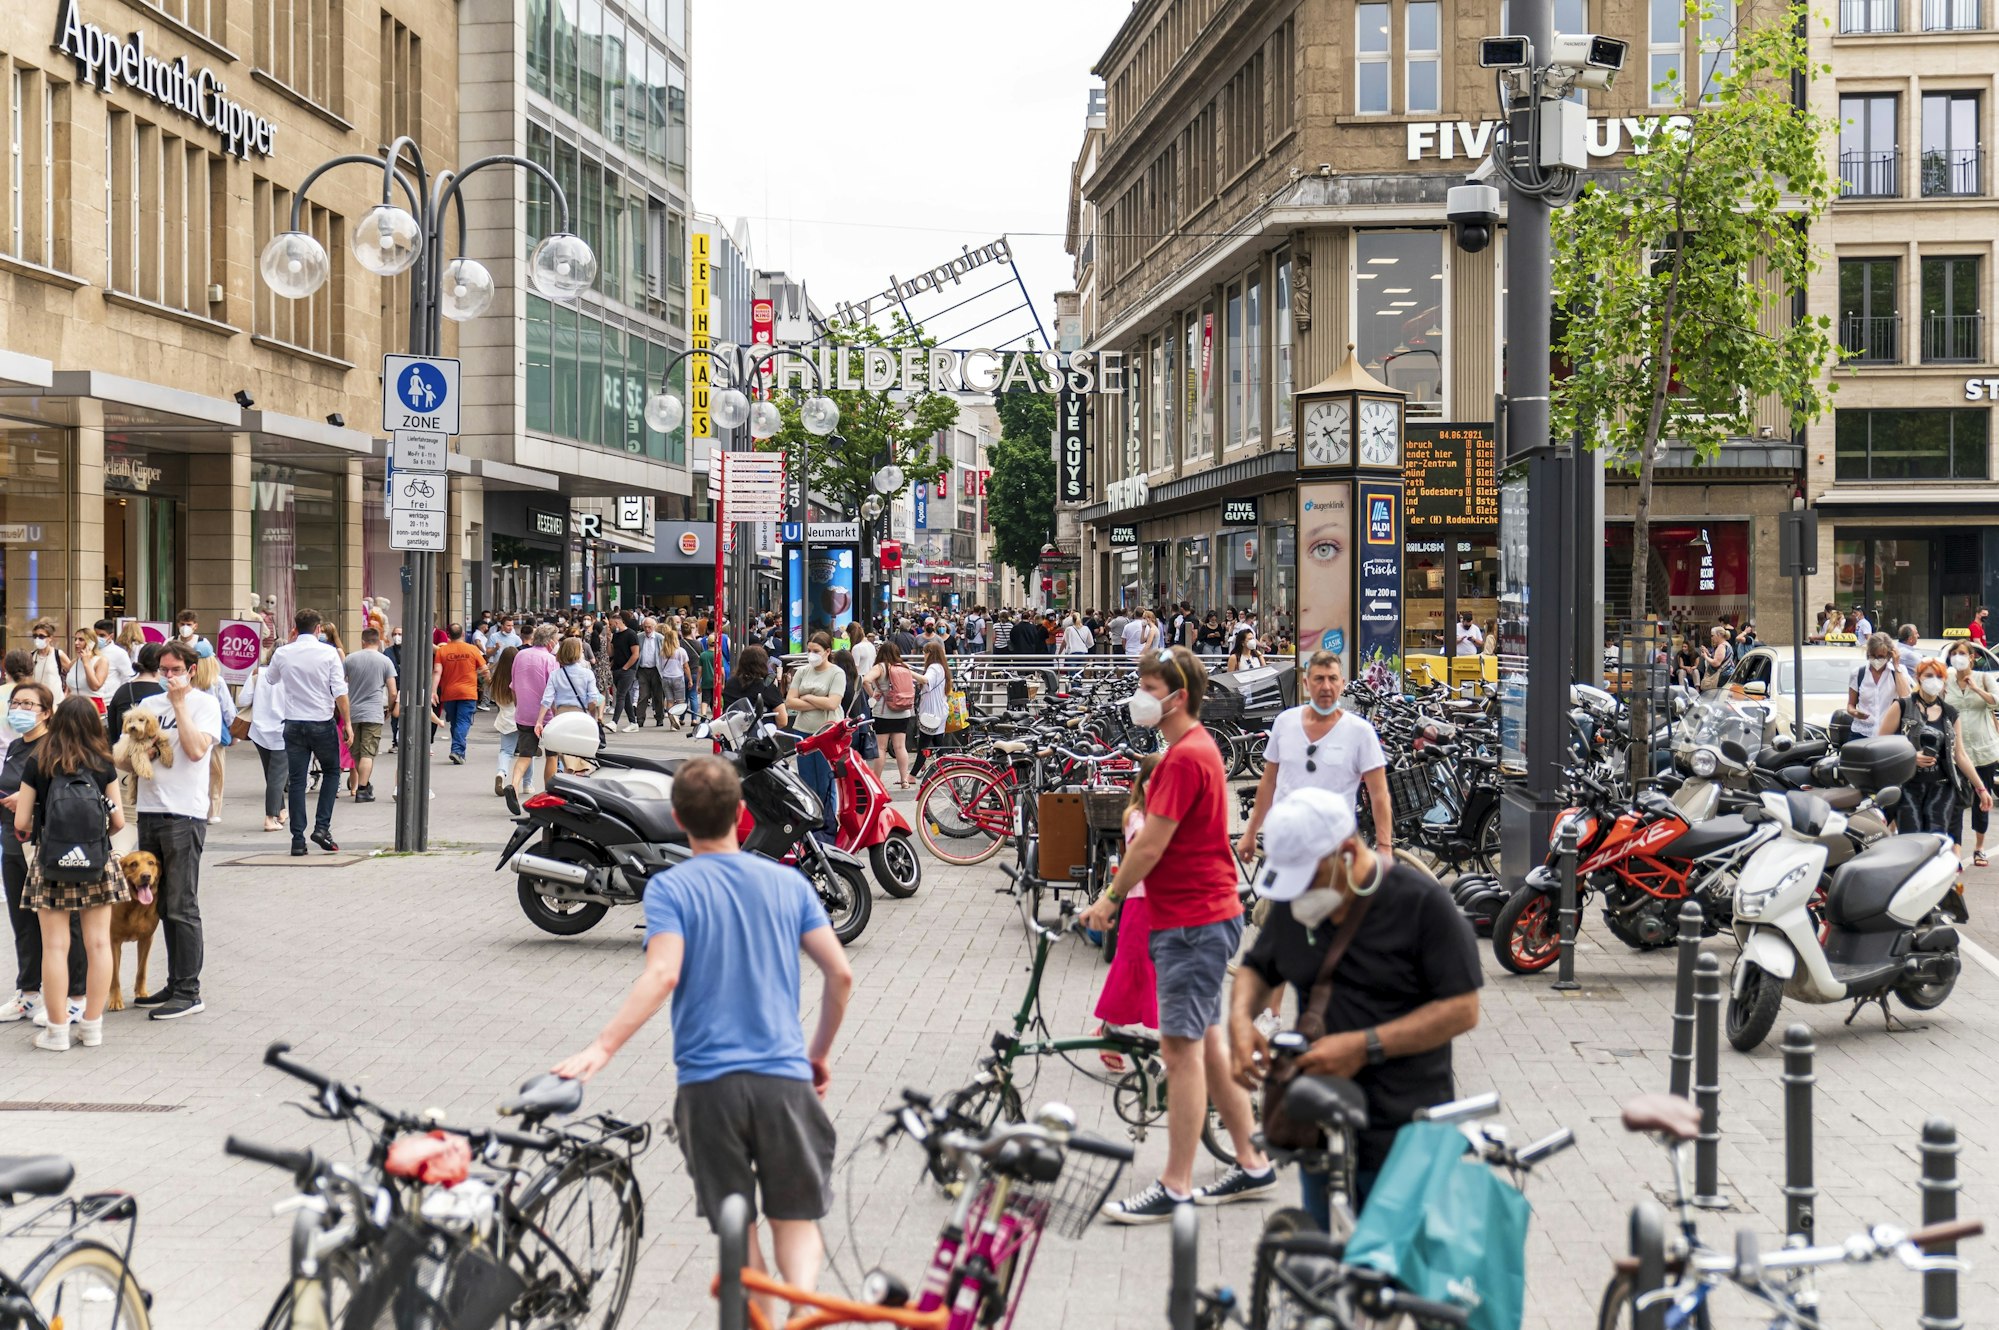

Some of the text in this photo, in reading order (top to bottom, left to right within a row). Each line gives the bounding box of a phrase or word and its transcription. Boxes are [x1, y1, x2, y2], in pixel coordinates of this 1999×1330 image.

[59, 0, 278, 162] AppelrathCüpper
[1407, 115, 1696, 161] FIV UYS
[884, 234, 1013, 307] shopping
[699, 237, 708, 435] LEIHHAUS
[711, 343, 1124, 395] SCHILDERGASSE
[1965, 379, 1999, 400] ST
[402, 415, 440, 429] ZONE
[1066, 372, 1081, 496] FIVE GUYS
[1440, 431, 1482, 439] 04.06.2021
[407, 436, 439, 444] Lieferfahrzeuge
[1406, 450, 1430, 458] endet
[1434, 450, 1453, 458] hier
[1466, 450, 1471, 458] H
[1466, 478, 1471, 486] H
[1420, 488, 1463, 497] Godesberg
[1476, 487, 1498, 495] Gleis
[410, 500, 428, 509] frei
[1313, 501, 1344, 511] augenklinik
[1466, 497, 1471, 505] H
[1476, 497, 1498, 506] Bstg.
[1227, 503, 1252, 512] FIVE
[1476, 506, 1498, 514] Gleis
[1224, 511, 1255, 521] GUYS
[1411, 516, 1425, 524] der
[1429, 515, 1442, 524] (H)
[536, 513, 563, 535] RESERVED
[580, 513, 601, 537] R
[1371, 522, 1390, 532] ALDI
[785, 524, 798, 540] U
[1113, 527, 1133, 535] FIVE
[1111, 534, 1136, 542] GUYS
[1363, 560, 1397, 577] Frische
[1365, 588, 1377, 597] Nur
[1377, 588, 1390, 597] 200
[221, 636, 255, 652] 20%
[1324, 636, 1343, 650] LASIK
[1576, 821, 1675, 876] DUKE
[58, 857, 91, 867] adidas
